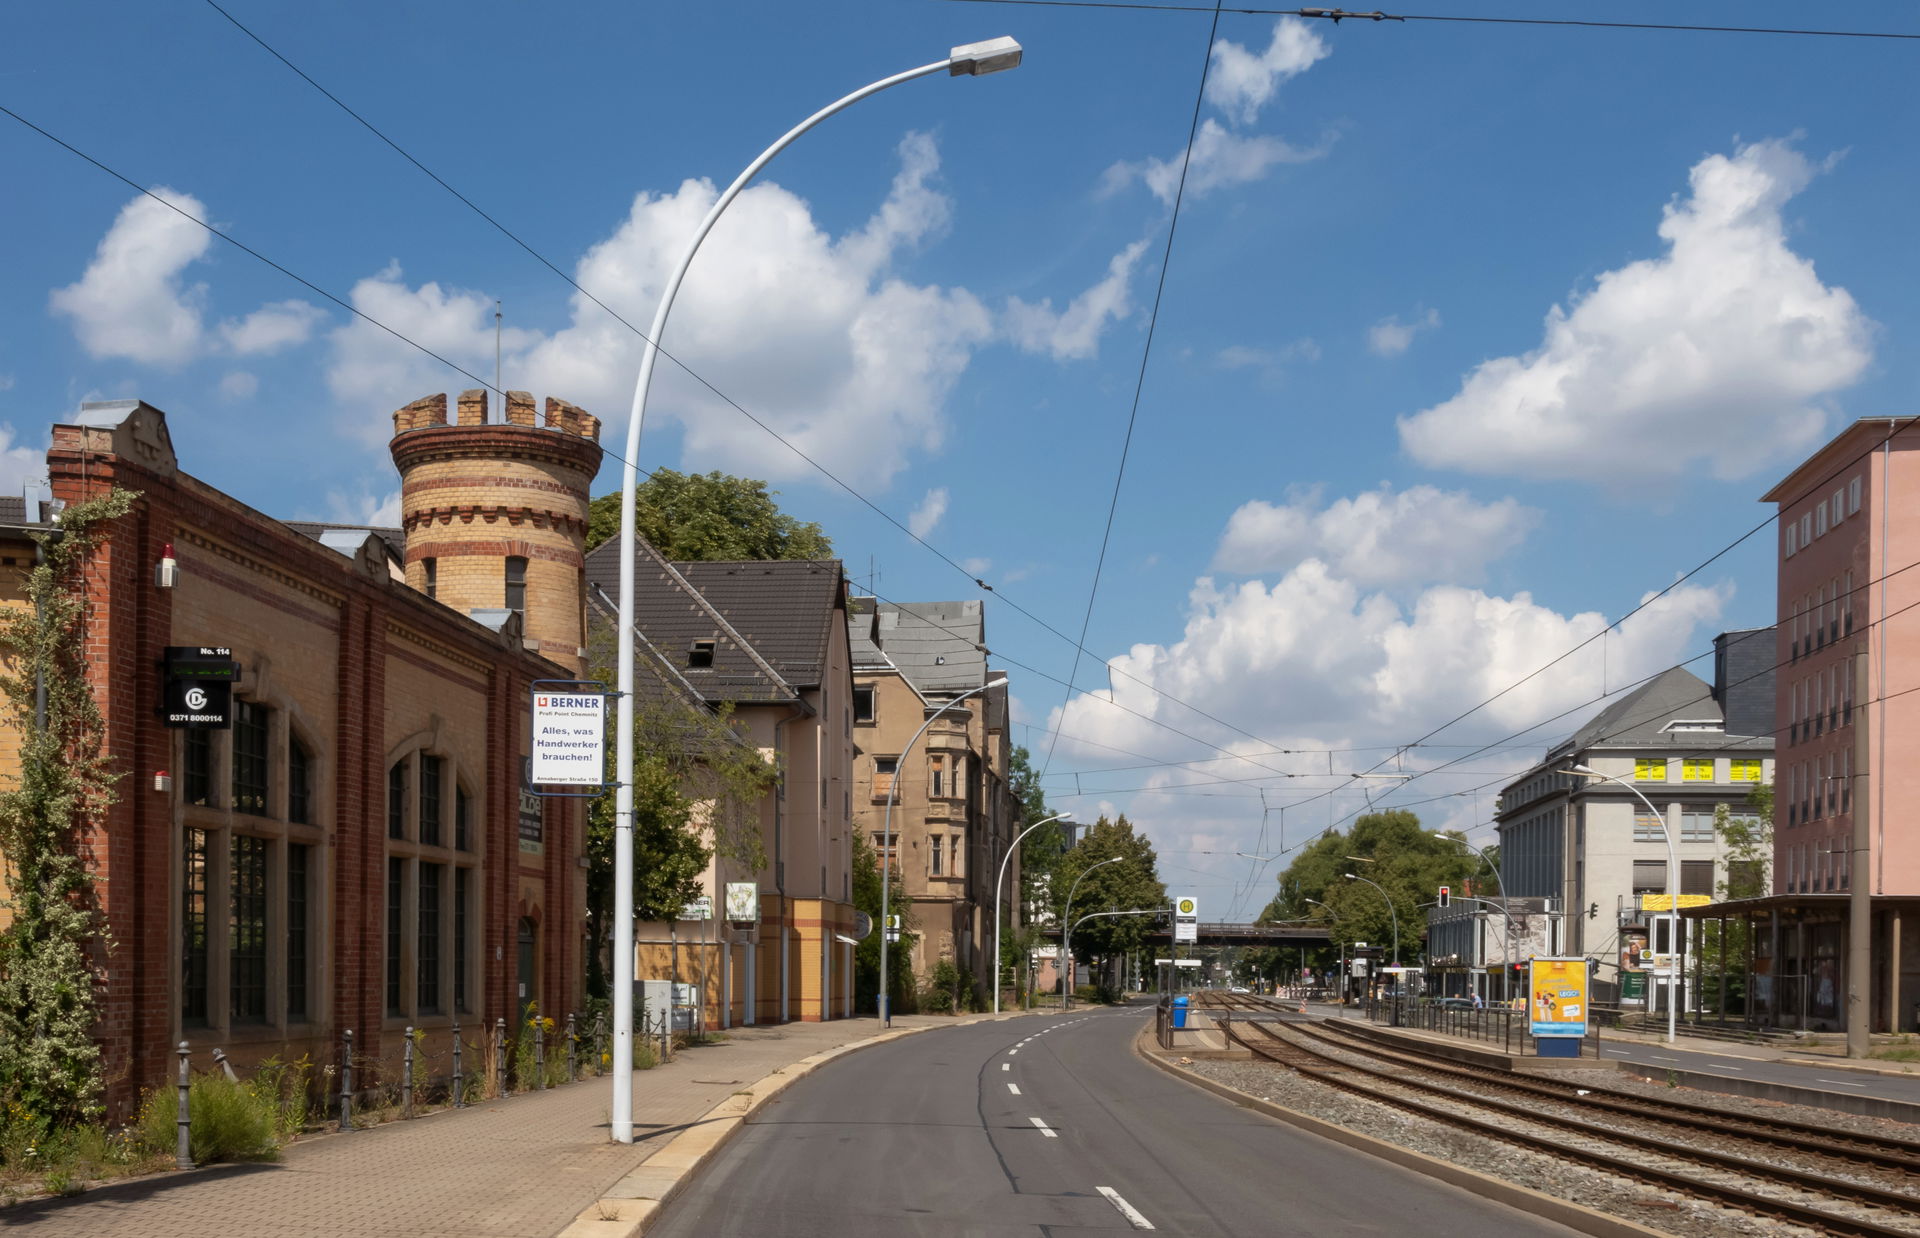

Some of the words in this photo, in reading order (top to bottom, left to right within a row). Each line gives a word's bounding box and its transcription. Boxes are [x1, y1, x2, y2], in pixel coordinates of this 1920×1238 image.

[552, 698, 599, 708] BERNER
[542, 726, 570, 736] Alles,
[537, 740, 598, 748] Handwerker
[542, 753, 592, 761] brauchen!
